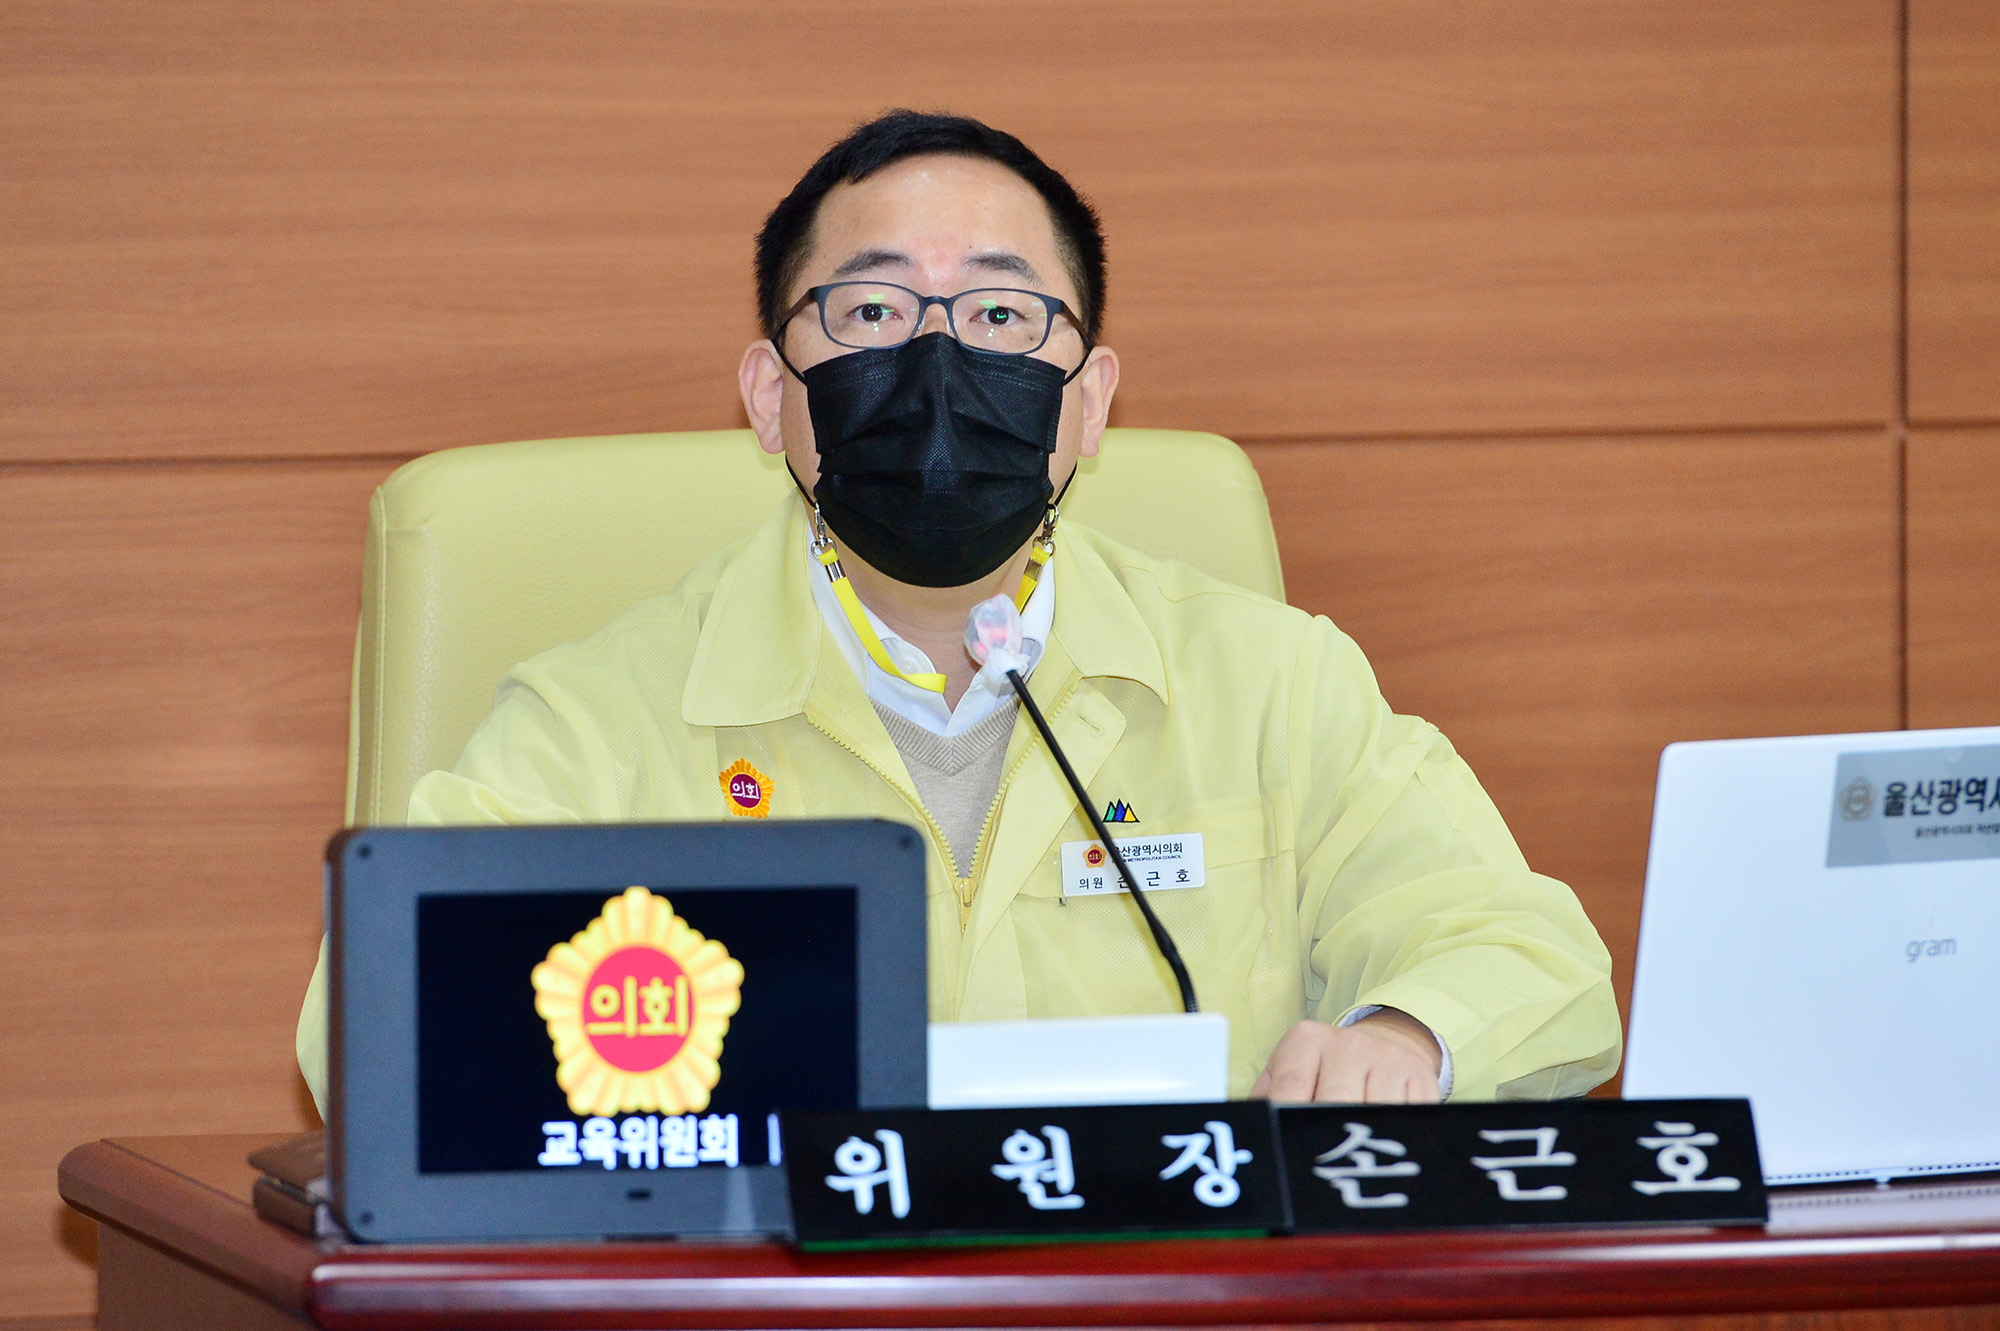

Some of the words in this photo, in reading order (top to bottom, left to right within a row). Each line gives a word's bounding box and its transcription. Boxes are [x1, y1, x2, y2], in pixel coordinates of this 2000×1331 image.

[732, 780, 759, 799] 의회
[1905, 938, 1957, 963] gram
[585, 975, 689, 1038] 의회
[538, 1114, 739, 1170] 교육위원회
